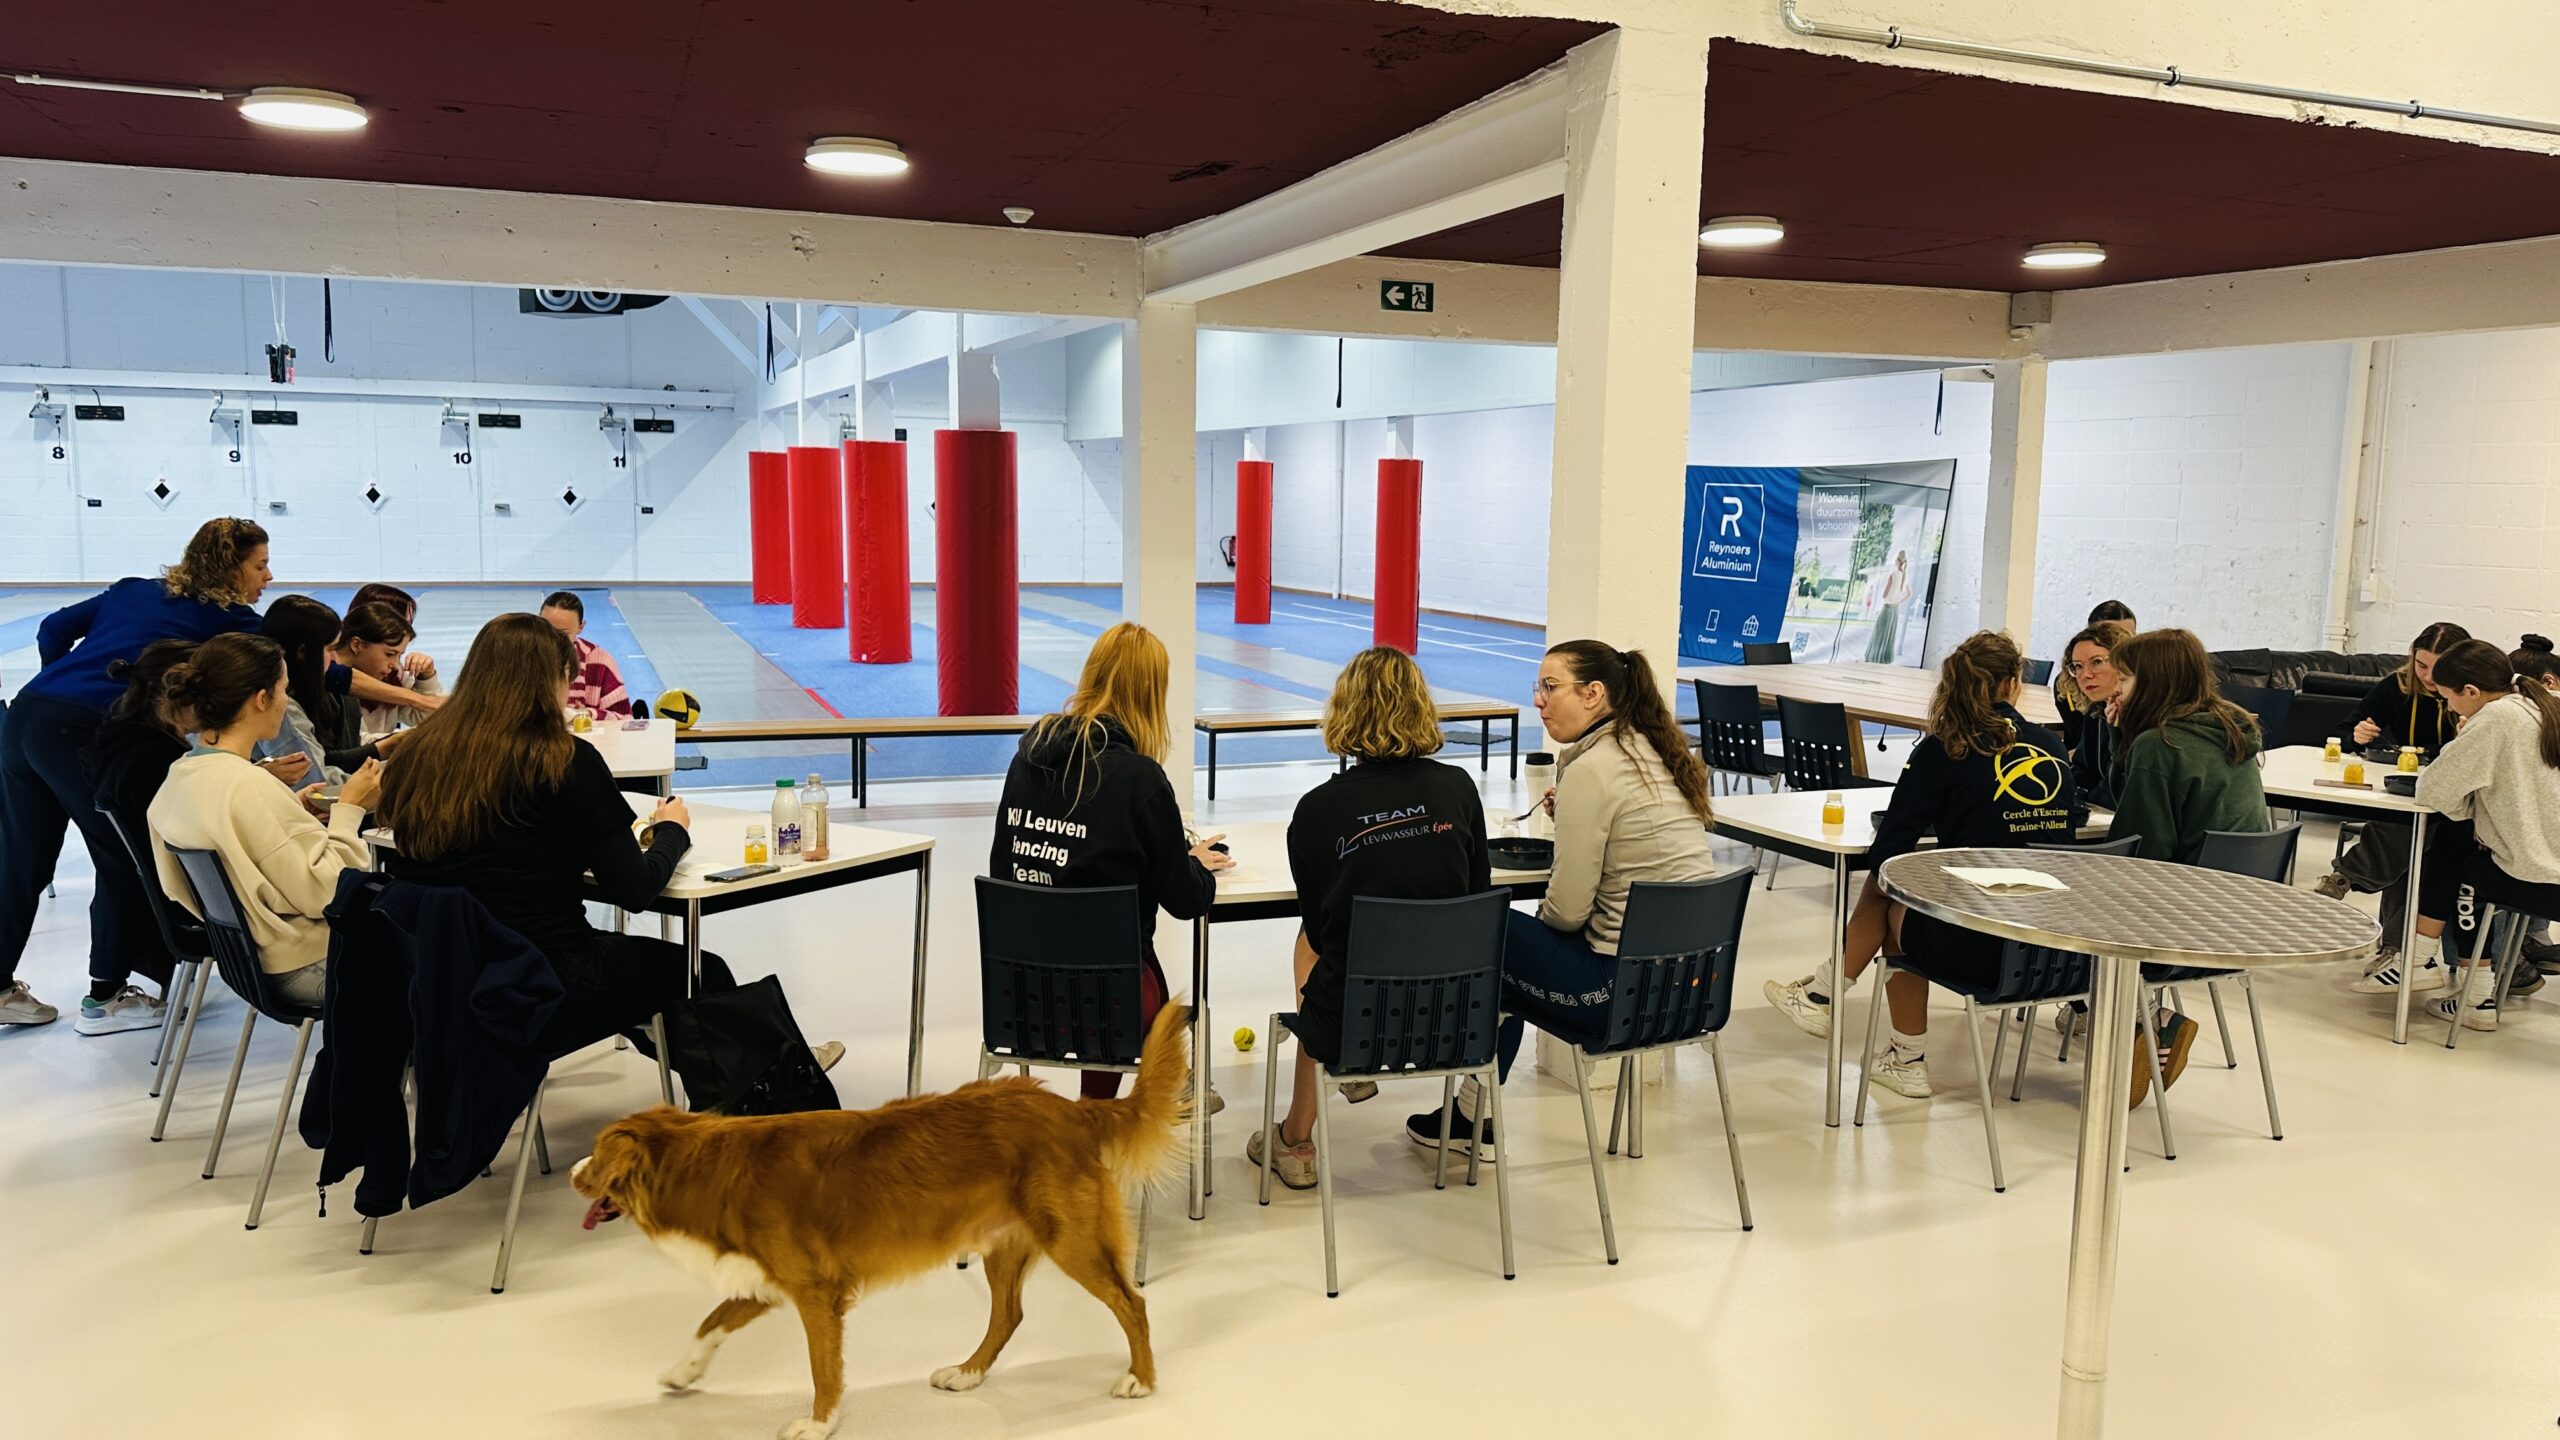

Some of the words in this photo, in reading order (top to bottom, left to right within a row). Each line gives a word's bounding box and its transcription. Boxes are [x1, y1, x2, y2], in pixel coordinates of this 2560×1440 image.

[52, 446, 65, 460] 8
[229, 450, 241, 462] 9
[453, 453, 472, 465] 10
[613, 456, 626, 468] 11
[1818, 492, 1849, 503] Wonen
[1850, 491, 1859, 503] in
[1816, 506, 1861, 517] duurzame
[1708, 540, 1751, 556] Reynaers
[1701, 556, 1752, 572] Aluminium
[1357, 805, 1426, 824] TEAM
[2002, 809, 2032, 820] Cercle
[2032, 807, 2069, 818] d'Escrime
[1024, 809, 1087, 839] Leuven
[2009, 820, 2067, 833] Braine-l'Alleud
[1363, 825, 1430, 846] LEVAVASSEUR
[1432, 820, 1453, 834] Épée
[1012, 862, 1053, 887] Team
[1548, 991, 1578, 1007] FILA
[1580, 987, 1610, 1006] FILA
